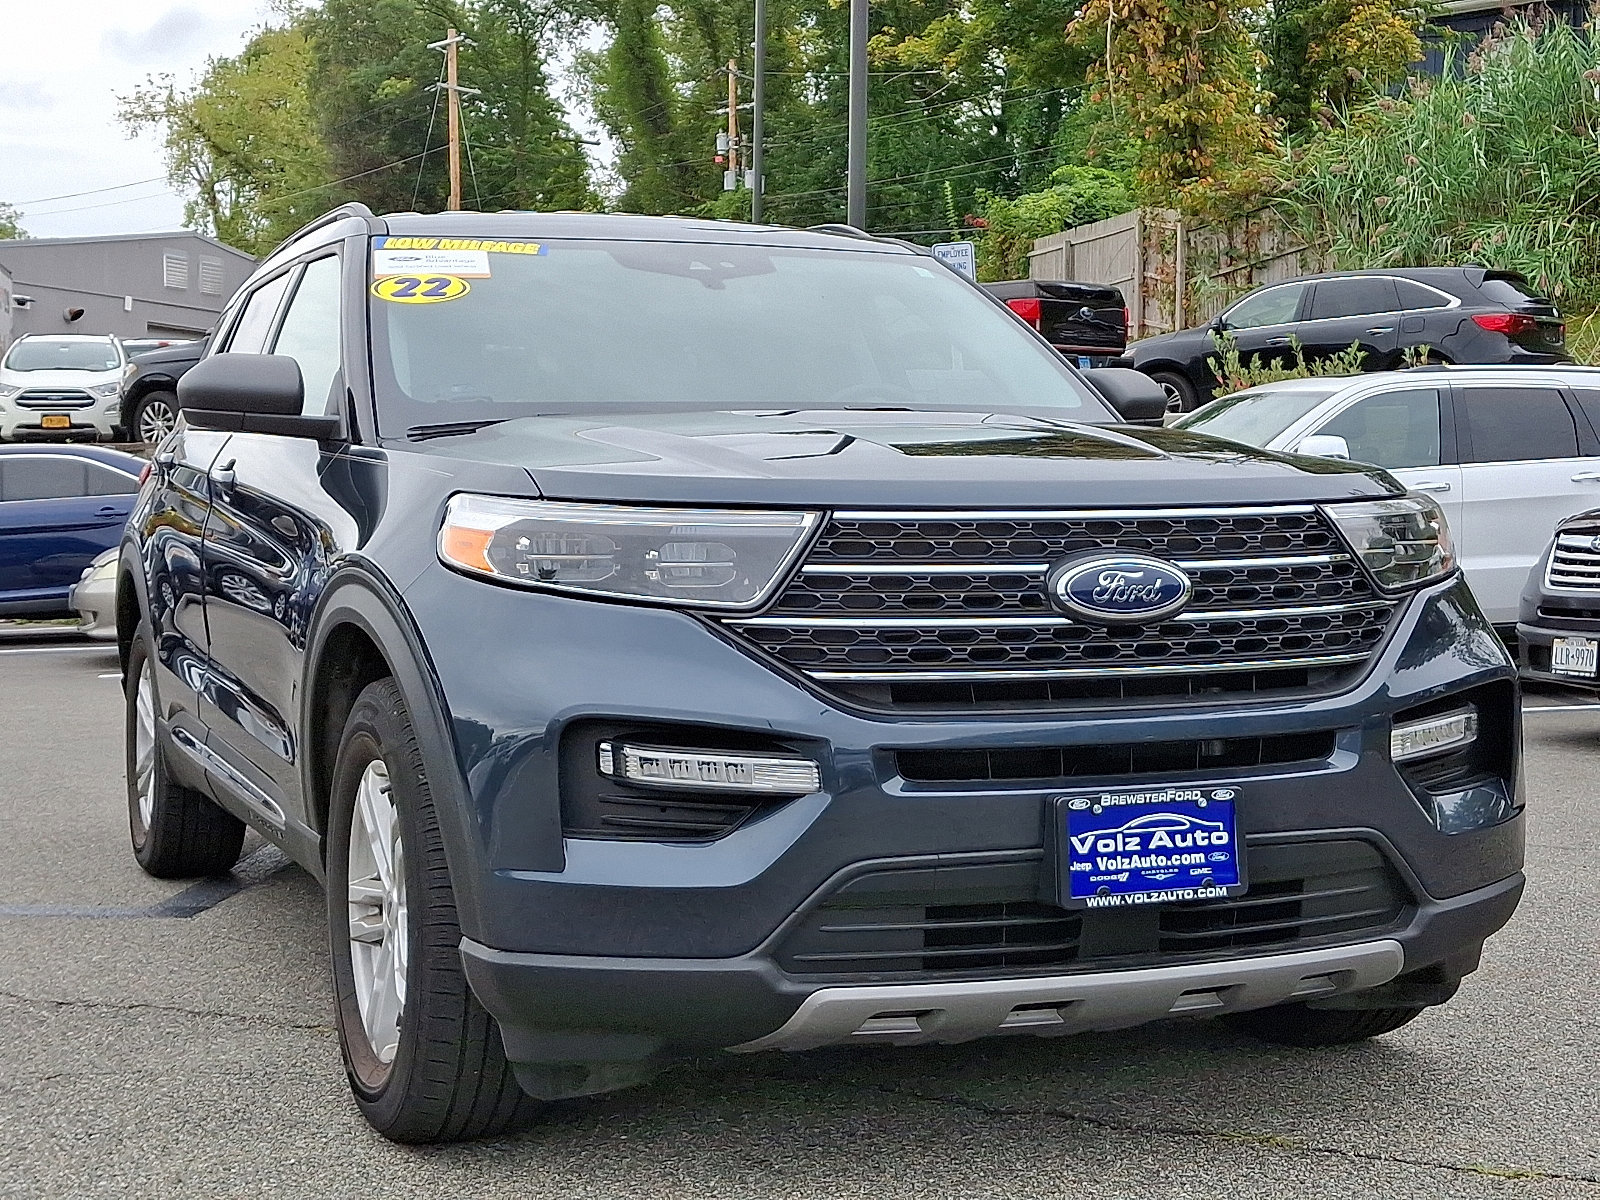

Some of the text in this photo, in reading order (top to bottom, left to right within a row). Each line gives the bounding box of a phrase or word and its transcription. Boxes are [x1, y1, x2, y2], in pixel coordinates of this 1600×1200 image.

[384, 238, 541, 255] LOW MILEAGE
[937, 248, 969, 258] EMPLOYEE
[390, 277, 452, 297] 22
[1092, 570, 1162, 603] Ford
[1070, 829, 1229, 854] Volz Auto
[1070, 861, 1092, 872] Jeep
[1096, 852, 1205, 871] VolzAuto.com
[1190, 867, 1213, 875] GMC
[1086, 886, 1228, 908] WWW.VOLZAUTO.COM
